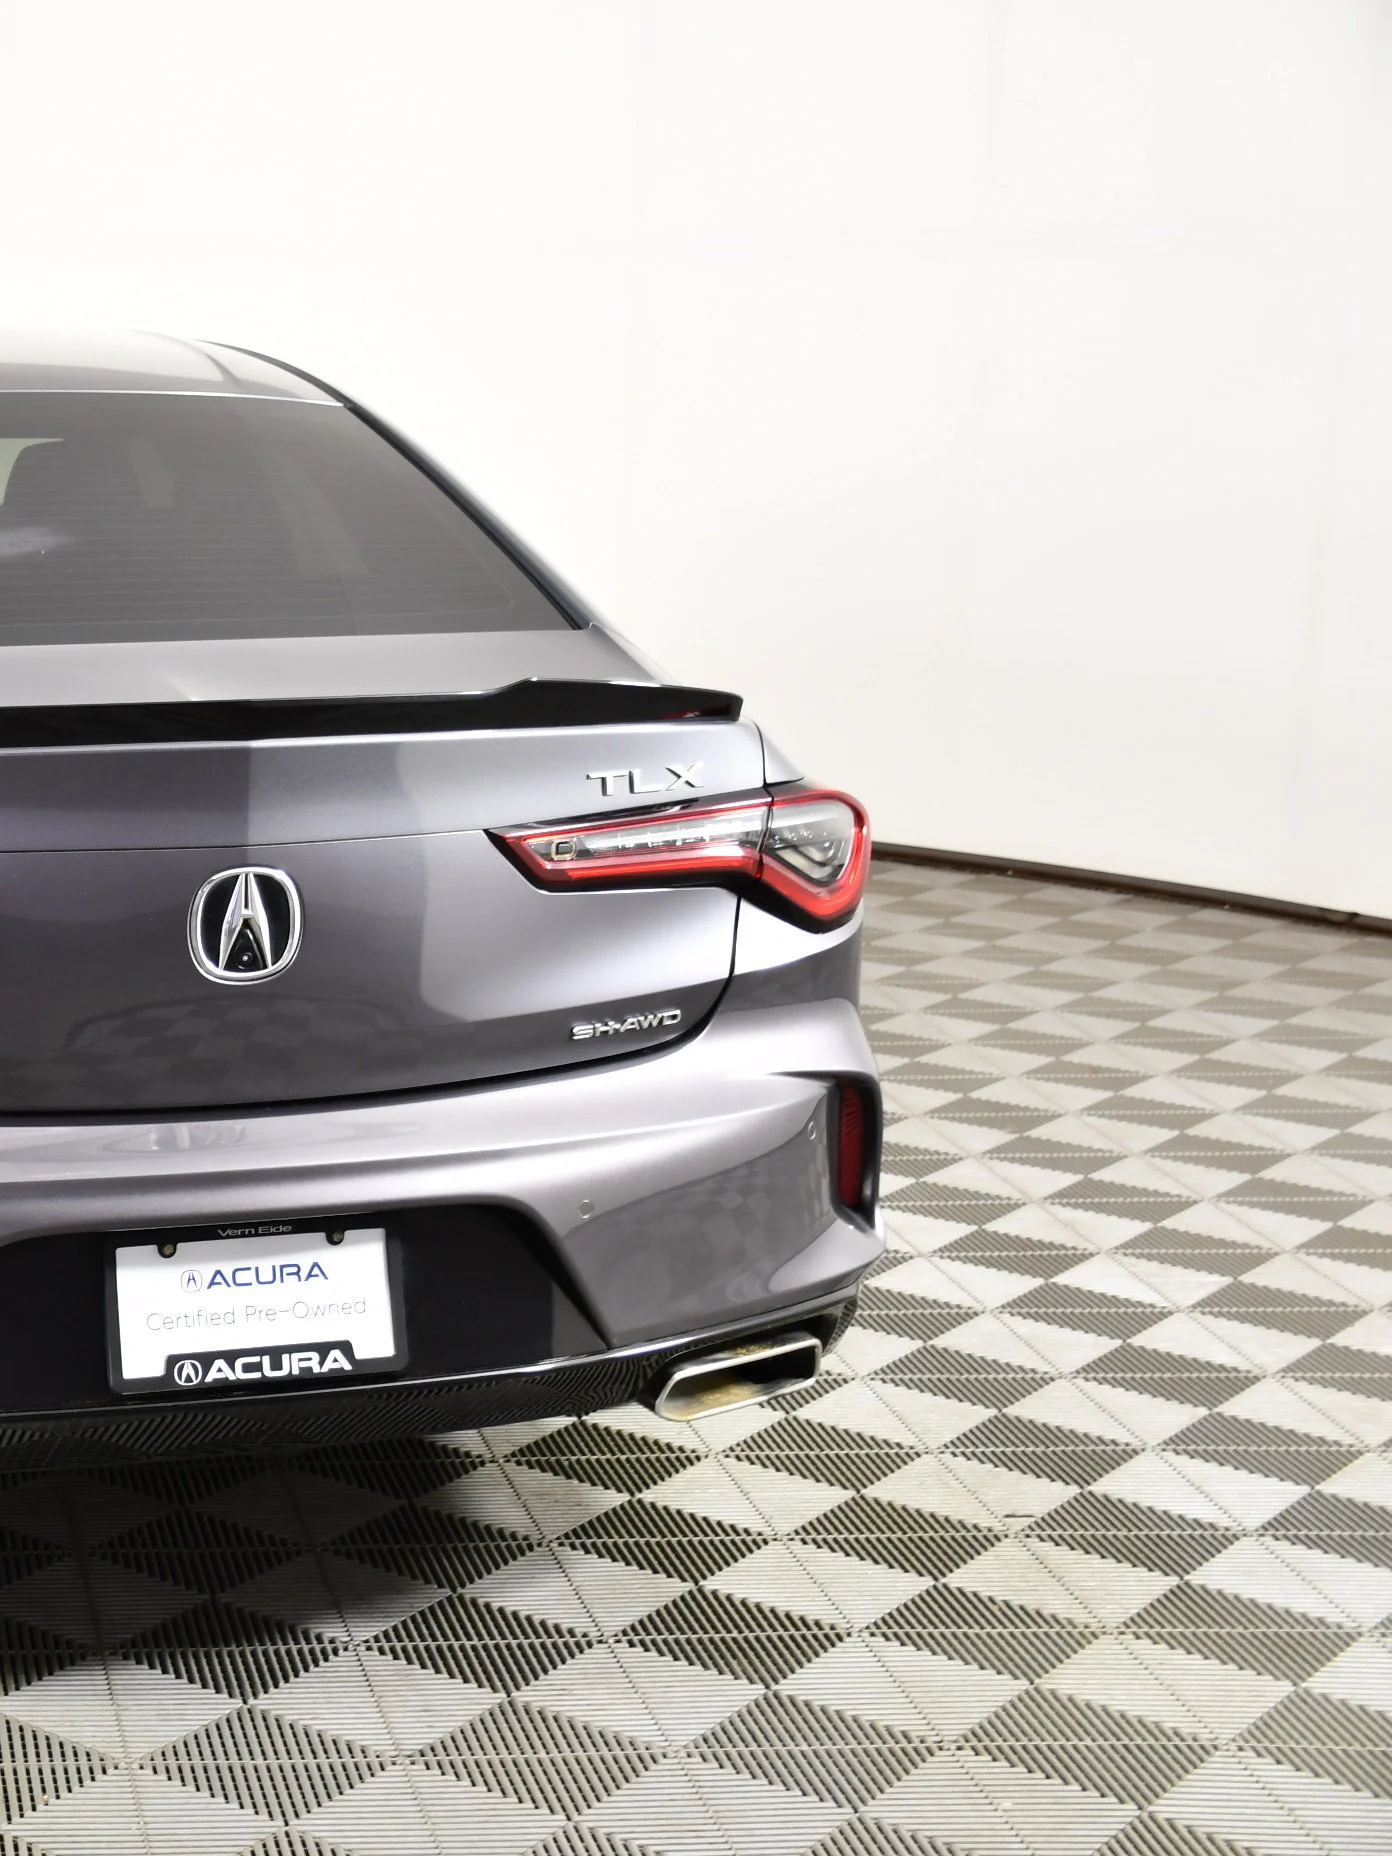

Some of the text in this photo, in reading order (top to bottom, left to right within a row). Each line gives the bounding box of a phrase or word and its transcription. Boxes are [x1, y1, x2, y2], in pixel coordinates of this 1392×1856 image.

[585, 760, 705, 797] TLX
[571, 1009, 682, 1040] SH-AWD
[217, 1224, 293, 1237] Vern Eide
[206, 1261, 329, 1289] ACURA
[146, 1297, 367, 1331] Certified Pre-Owned
[204, 1349, 353, 1383] ACURA
